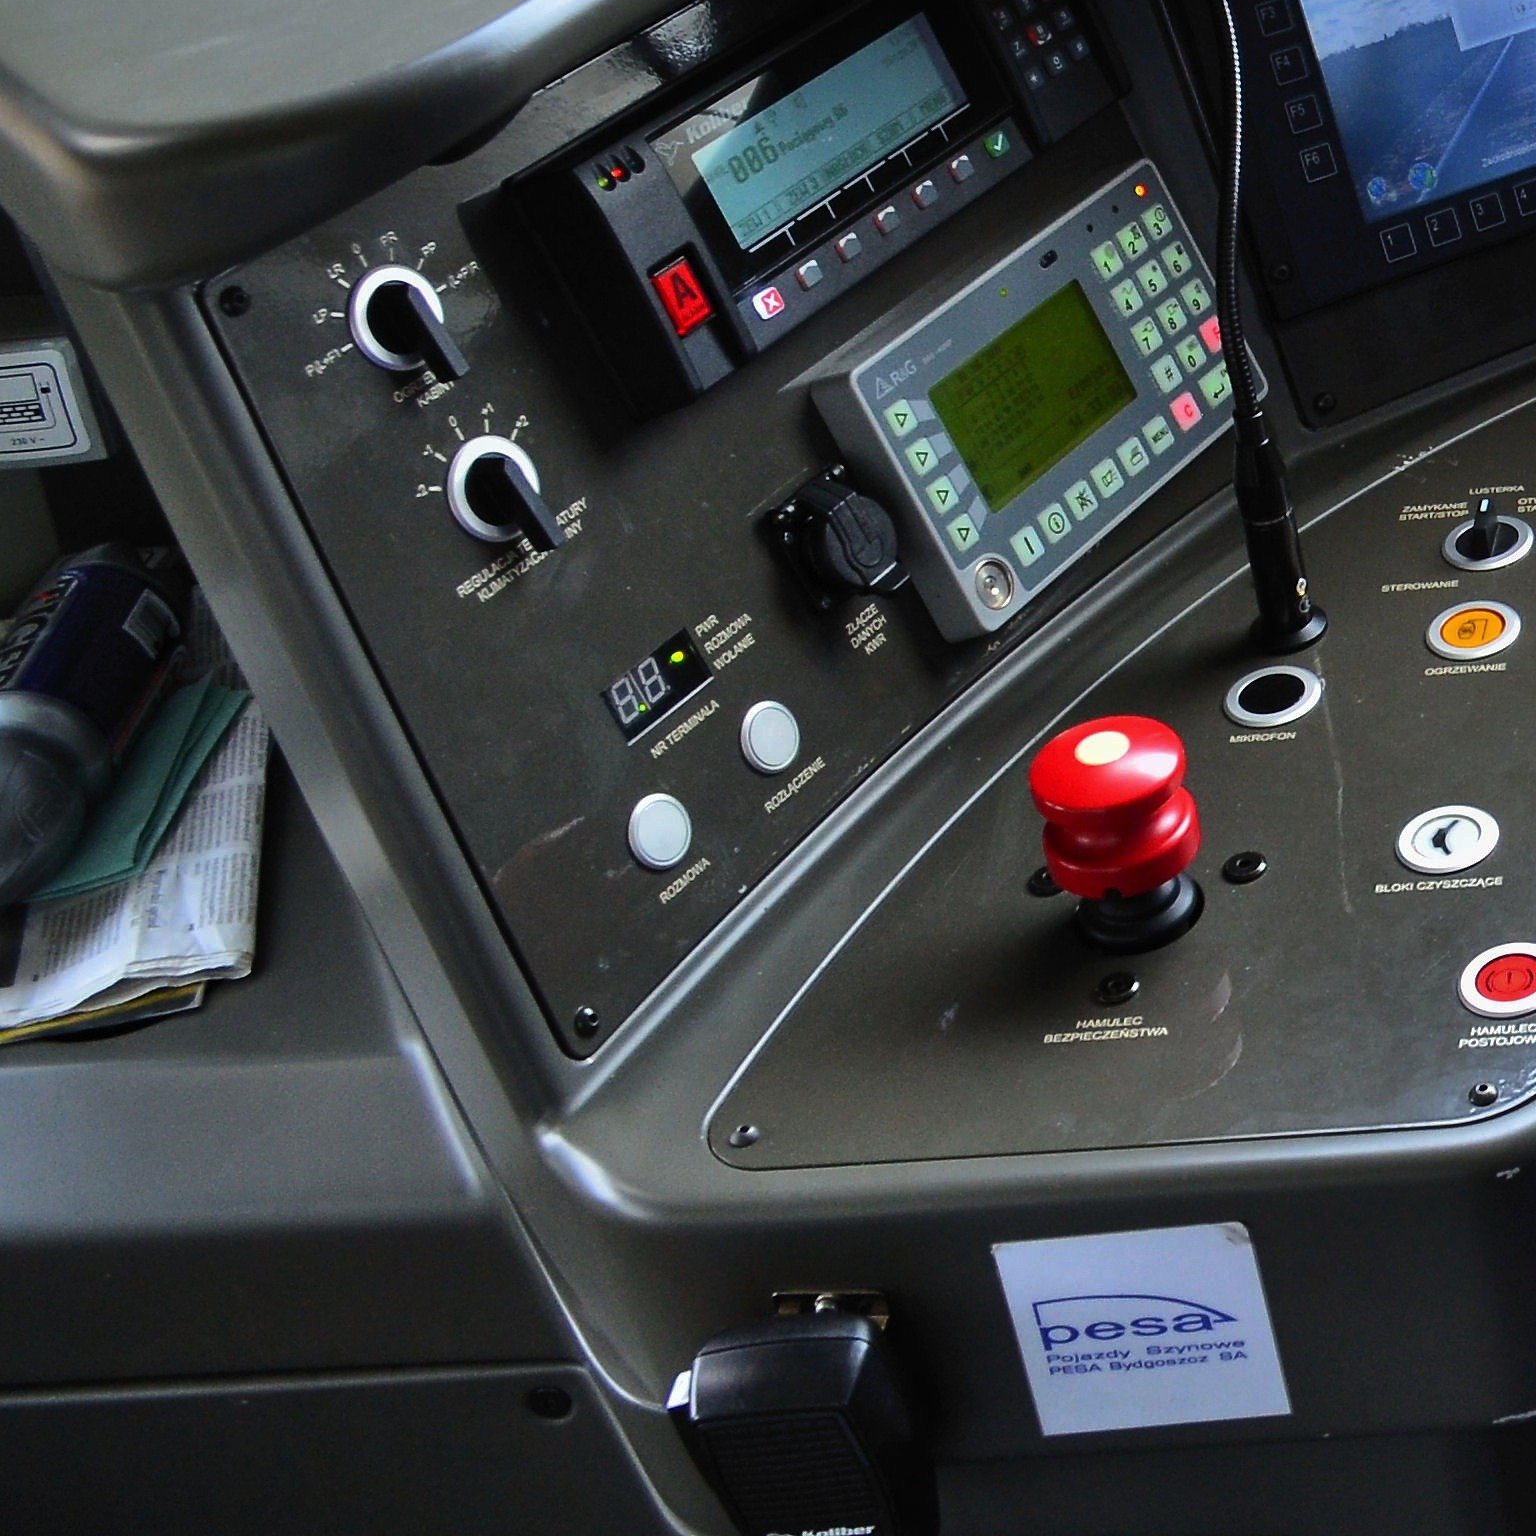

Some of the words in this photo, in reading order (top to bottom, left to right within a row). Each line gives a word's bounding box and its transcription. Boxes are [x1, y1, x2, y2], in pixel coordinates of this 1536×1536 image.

[380, 230, 398, 246] PR
[421, 241, 437, 256] PP
[326, 263, 345, 279] LR
[671, 273, 698, 309] A
[312, 308, 328, 324] LP
[1151, 426, 1170, 444] MENU
[1469, 485, 1525, 495] LUSTERKA
[1398, 510, 1469, 521] START/STOP
[1401, 502, 1468, 513] ZAMYKANIE
[1381, 580, 1459, 592] STEROWANIE
[694, 614, 720, 638] PWR
[845, 603, 879, 636] ZŁĄCZE
[704, 613, 753, 655] ROZMOWA
[850, 615, 887, 650] DANYCH
[713, 632, 756, 670] WOŁANIE
[864, 632, 887, 656] KWR
[1424, 663, 1507, 677] OGRZEWANIE
[650, 741, 668, 759] NR
[666, 699, 720, 747] TERMINALA
[1229, 731, 1297, 743] MIKROFON
[763, 756, 826, 814] ROZŁĄCZENIE
[659, 857, 711, 904] ROZMOWA
[1374, 880, 1415, 894] BLOKI
[1416, 875, 1503, 893] CZYSZCZĄCE
[1076, 1016, 1143, 1029] HAMULEC
[1043, 1026, 1169, 1044] BEZPIECZEŃSTWA
[1040, 1313, 1213, 1351] pesa
[1047, 1349, 1130, 1364] Pojazdy
[1146, 1339, 1246, 1355] Szynowe
[1049, 1364, 1102, 1375] PESA
[1110, 1354, 1208, 1371] Bydgoszcz
[1219, 1351, 1247, 1361] SA
